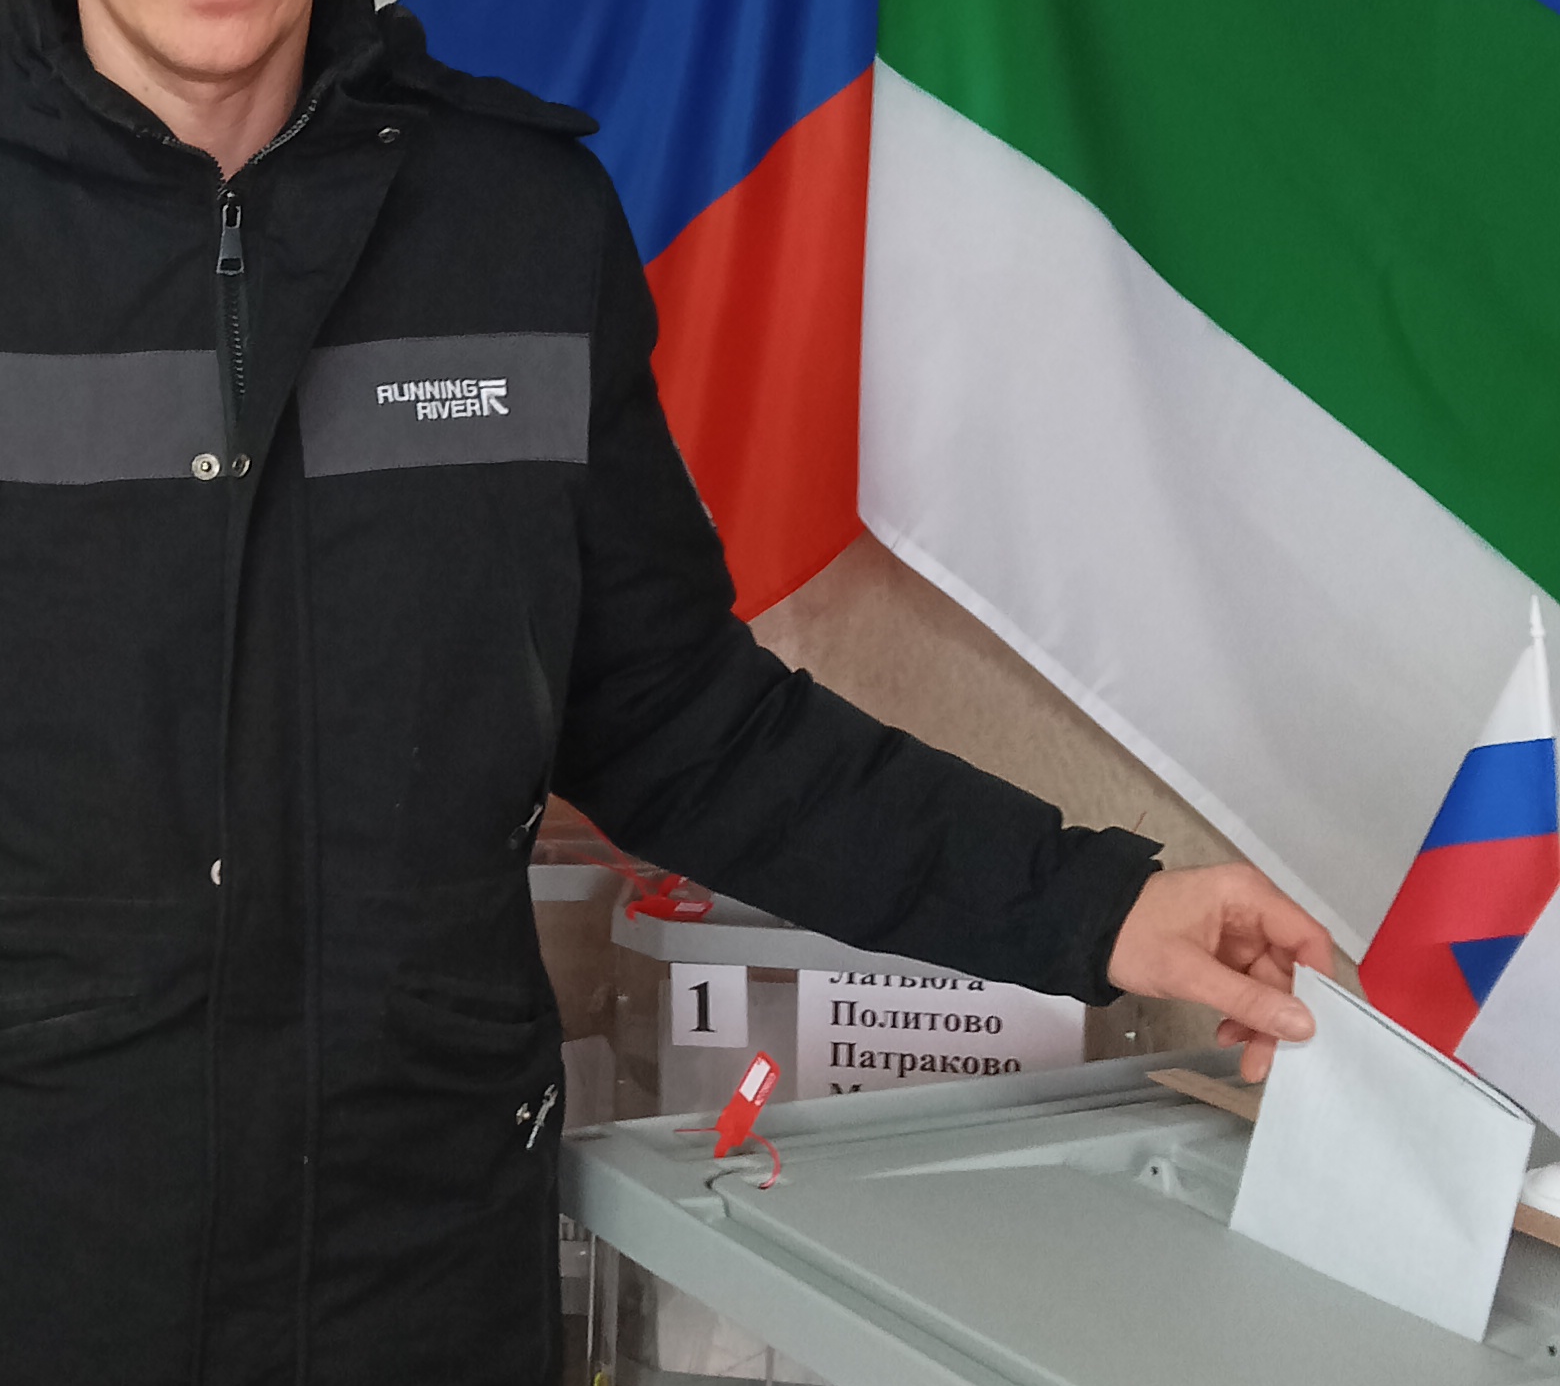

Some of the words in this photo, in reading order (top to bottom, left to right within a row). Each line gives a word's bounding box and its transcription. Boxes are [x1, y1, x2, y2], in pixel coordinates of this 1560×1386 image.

[376, 378, 478, 405] RUNNING
[416, 398, 482, 421] RIVER
[687, 980, 718, 1033] 1
[829, 999, 1003, 1034] Политово
[829, 1041, 1022, 1078] Патраково
